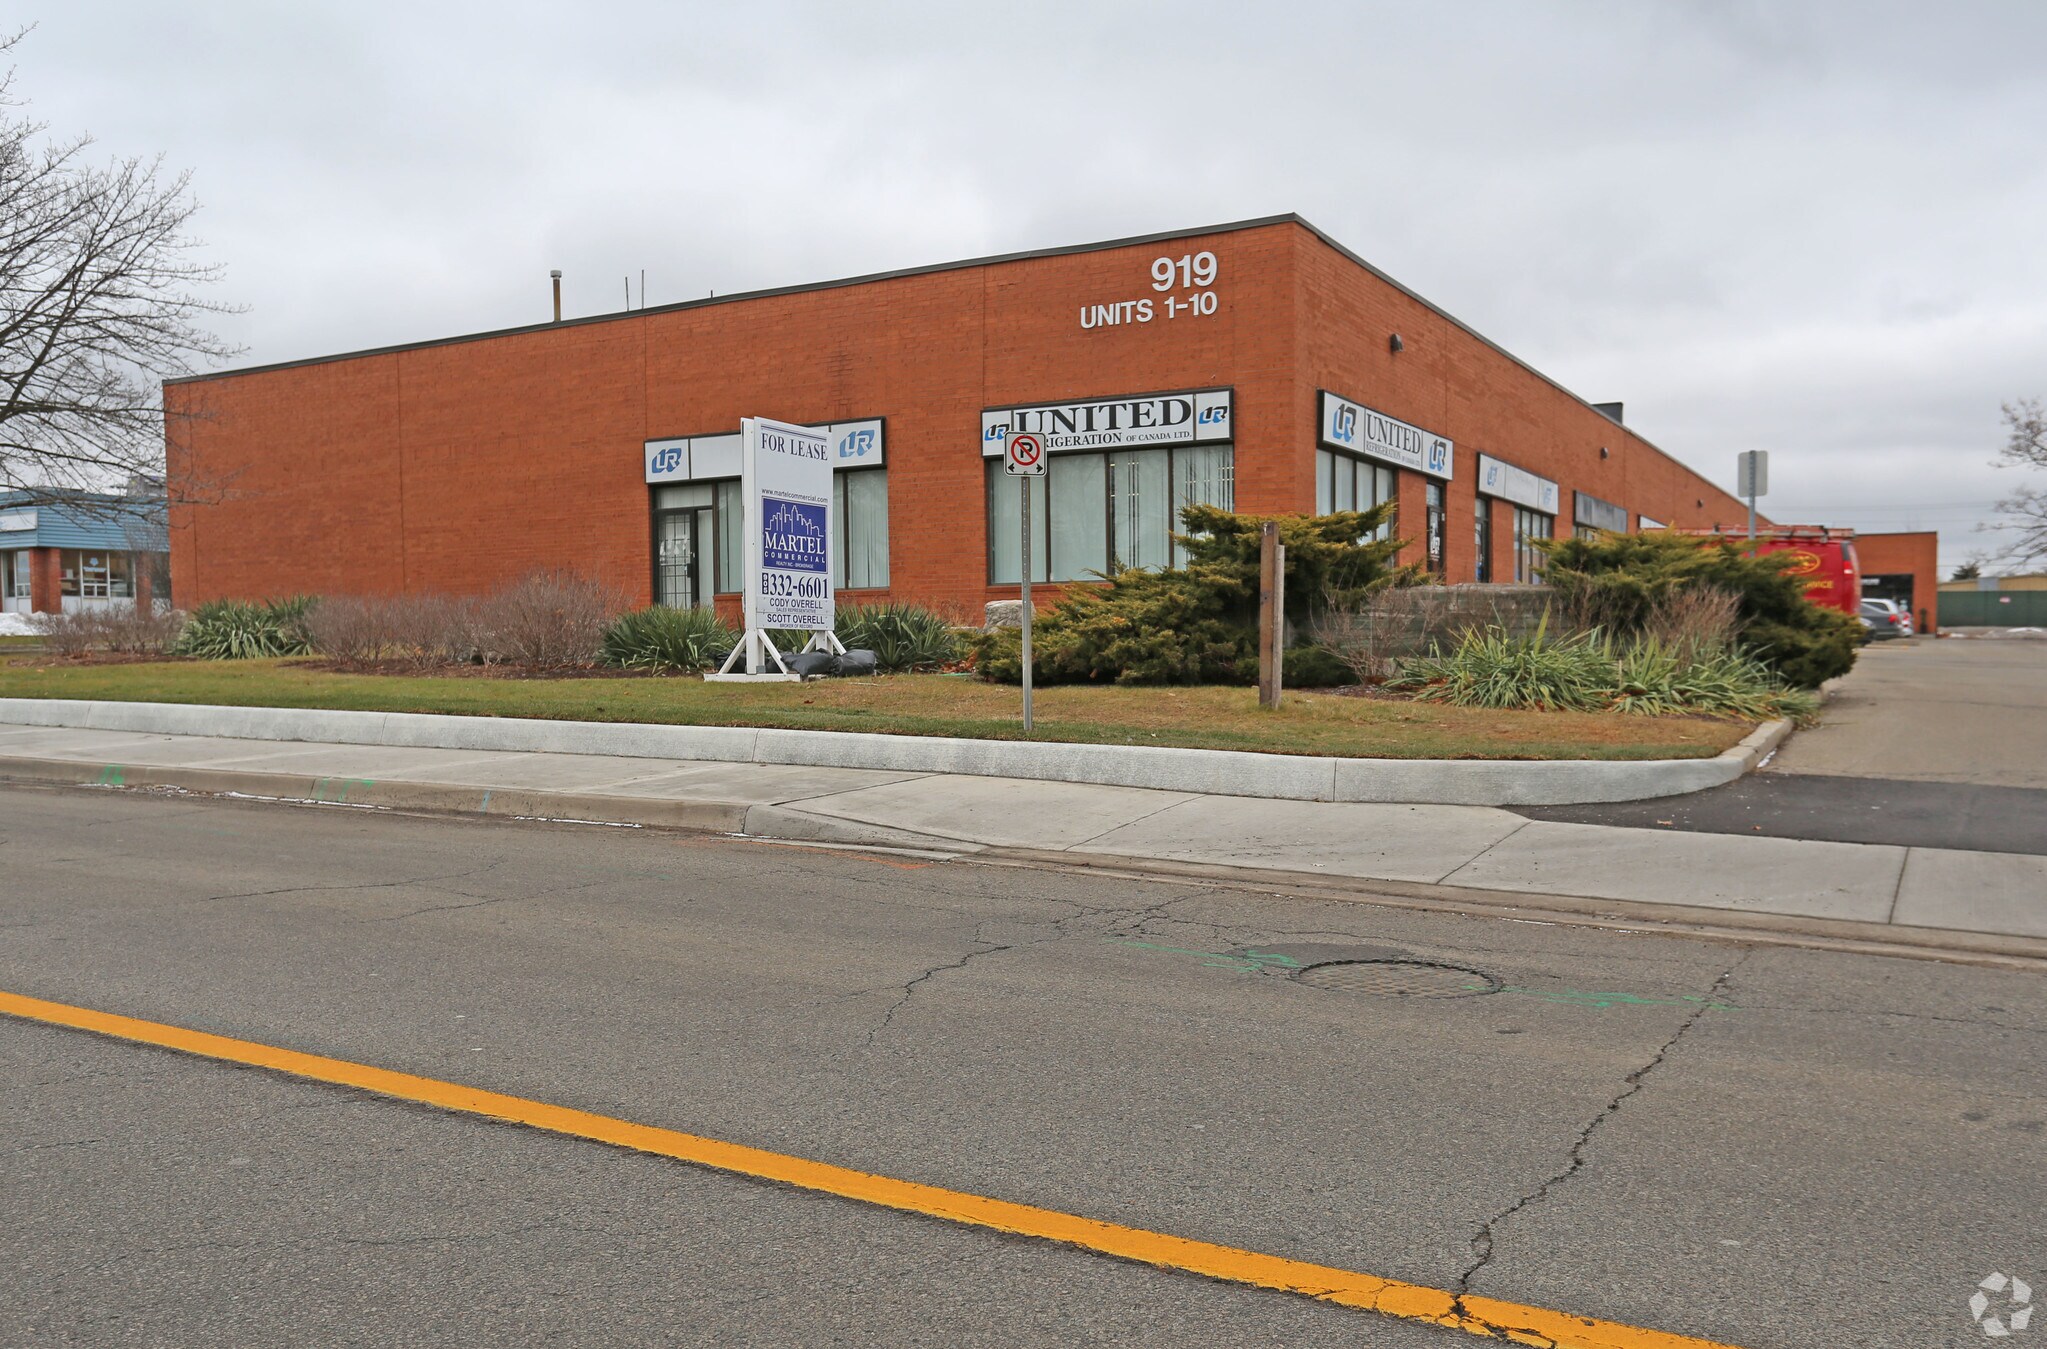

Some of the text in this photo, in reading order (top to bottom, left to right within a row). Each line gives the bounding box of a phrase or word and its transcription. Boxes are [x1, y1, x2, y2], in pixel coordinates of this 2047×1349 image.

[1151, 251, 1217, 292] 919
[1080, 291, 1218, 329] UNITS 1-10
[1016, 398, 1192, 435] UNITED
[1138, 433, 1171, 442] CANADA
[1366, 413, 1421, 455] UNITED
[761, 433, 828, 461] FOR LEASE
[761, 489, 829, 503] www.martelcommercial.com
[765, 532, 825, 554] MARTEL
[765, 551, 825, 563] COMMERCIAL
[769, 573, 829, 599] 332-6601
[769, 598, 823, 609] CODY OVERELL
[767, 613, 825, 625] SCOTT OVERELL
